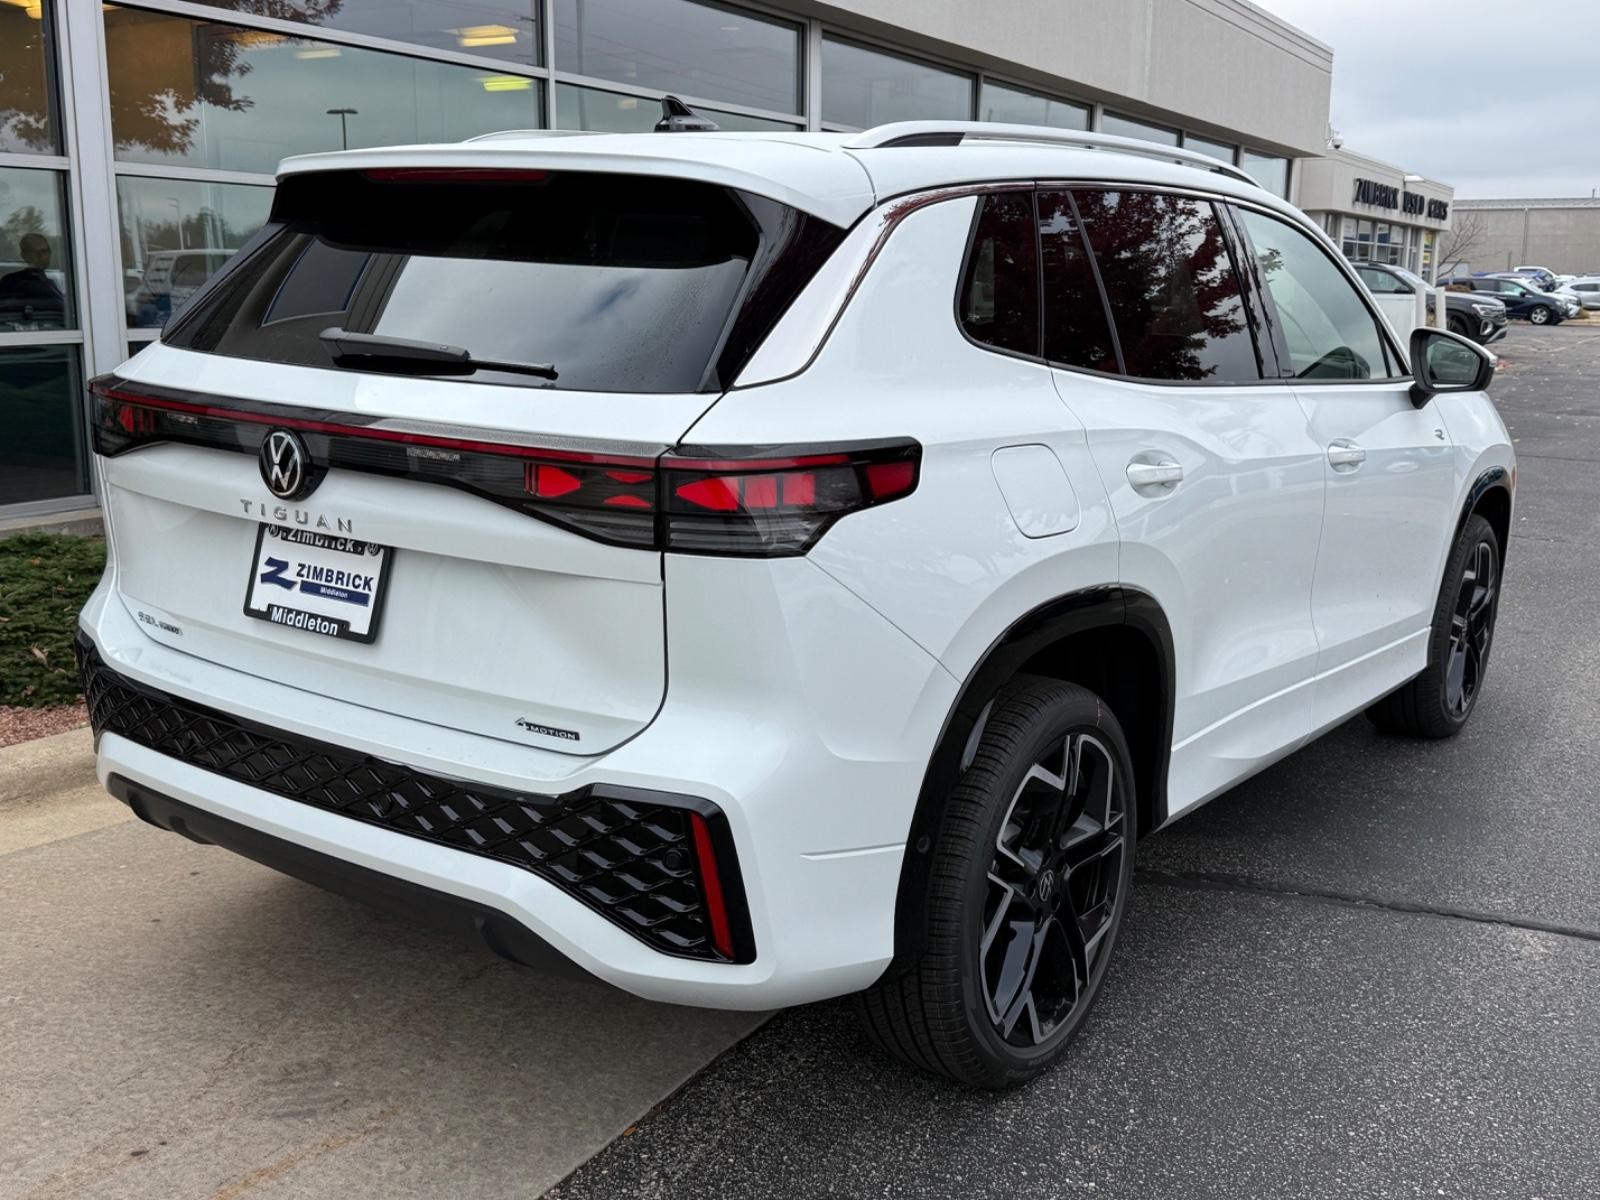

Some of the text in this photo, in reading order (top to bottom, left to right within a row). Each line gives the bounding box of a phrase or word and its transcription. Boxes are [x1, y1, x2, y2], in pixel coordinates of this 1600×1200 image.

[240, 499, 352, 533] TIGUAN
[296, 563, 374, 592] ZIMBRICK
[319, 586, 348, 599] Middleton
[271, 606, 338, 636] Middleton
